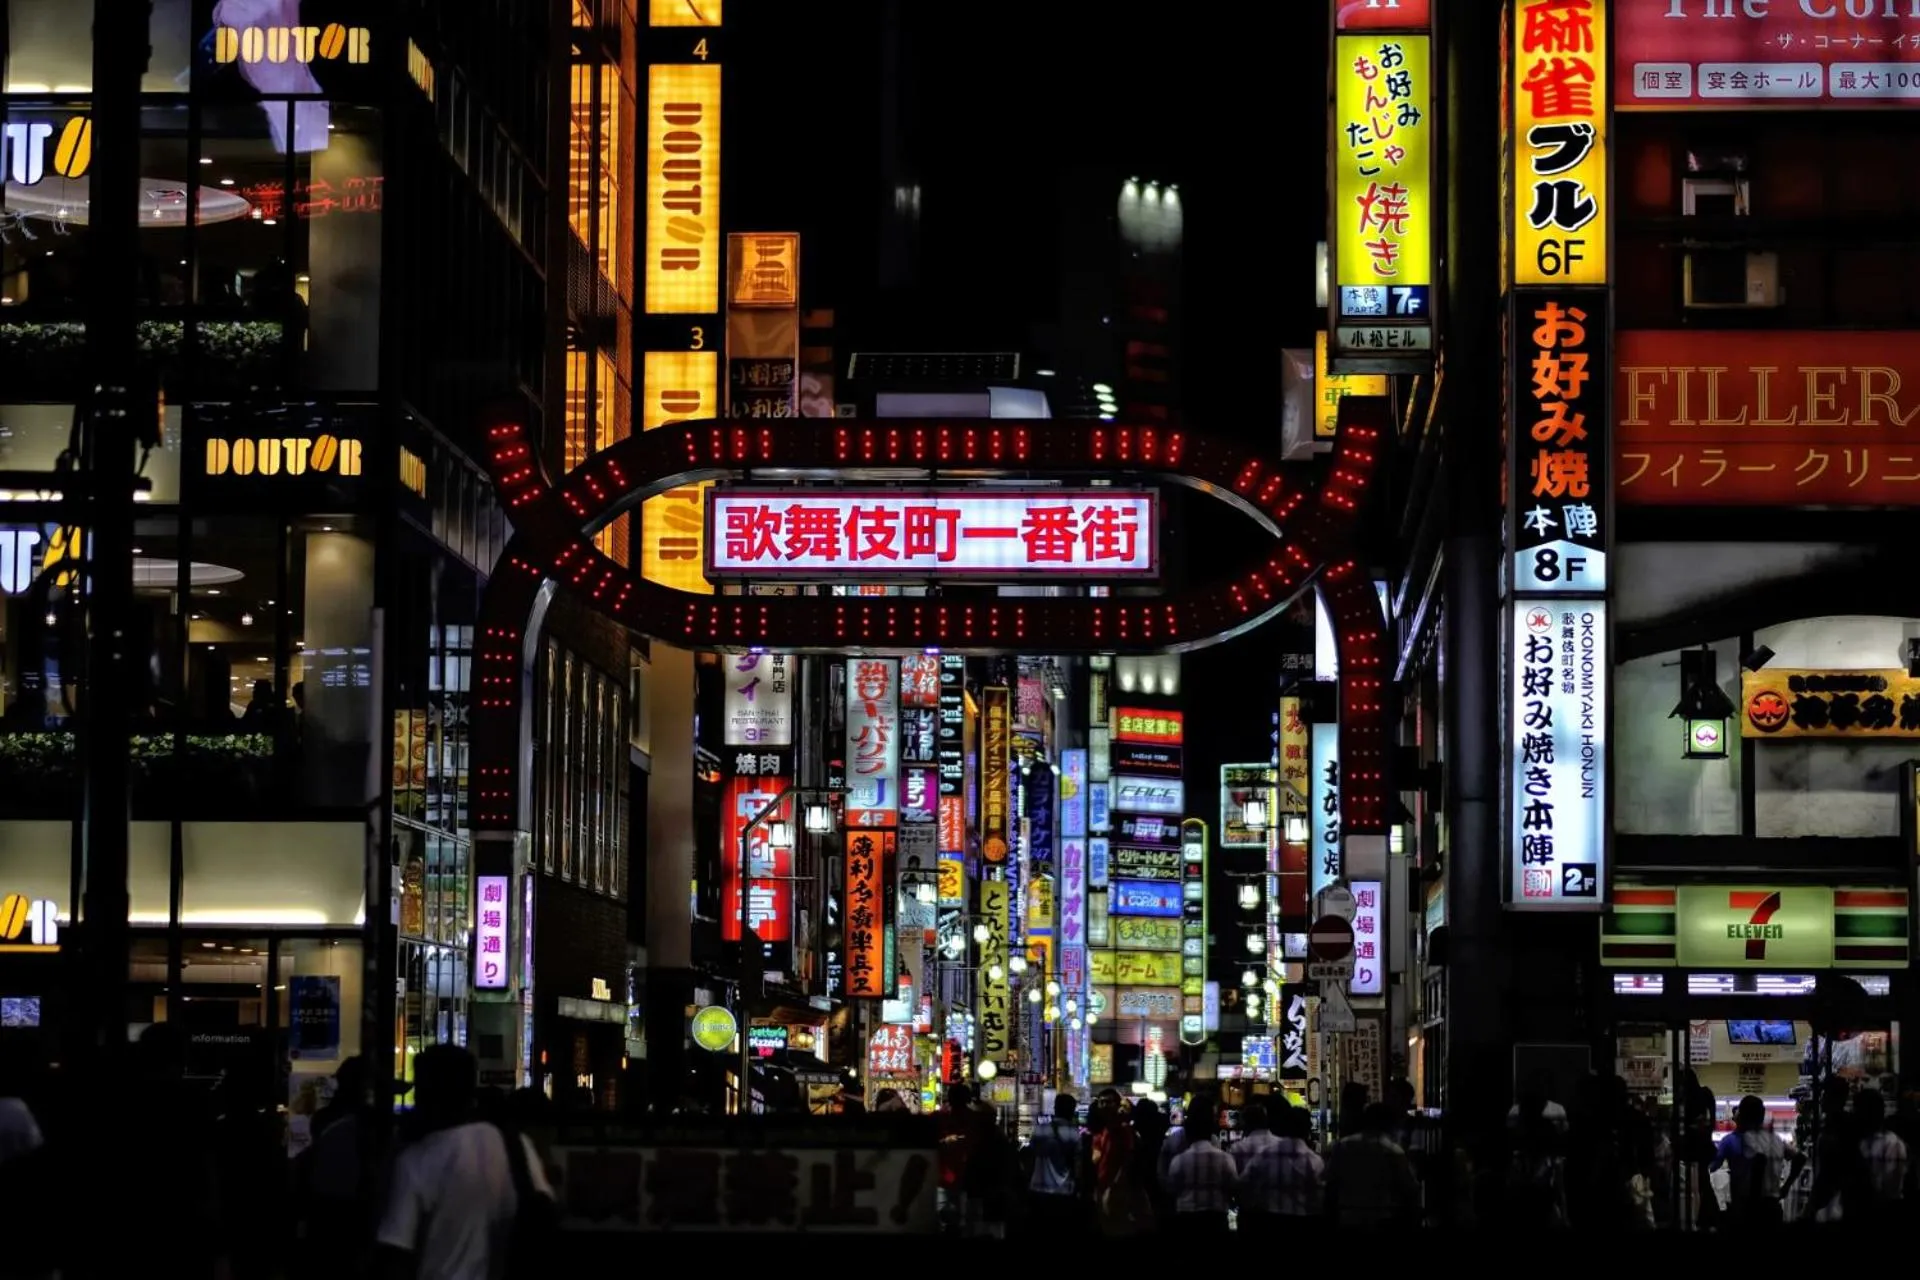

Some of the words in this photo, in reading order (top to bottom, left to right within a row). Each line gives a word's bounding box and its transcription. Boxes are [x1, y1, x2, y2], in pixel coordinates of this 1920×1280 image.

[215, 23, 370, 63] DOUTOR
[692, 37, 710, 61] 4
[1378, 43, 1421, 127] お好み
[1642, 71, 1684, 89] 個室
[1707, 71, 1817, 89] 宴会ホール
[1354, 56, 1405, 166] もんじゃ
[1347, 122, 1380, 176] たこ
[660, 102, 706, 271] DOUTOR
[1357, 183, 1410, 276] 焼き
[1537, 239, 1586, 276] 6F
[1391, 287, 1421, 314] 7F
[690, 326, 705, 350] 3
[1351, 330, 1415, 348] 小松ビル
[1530, 302, 1590, 498] お好み焼
[1620, 366, 1910, 426] FILLER
[206, 434, 362, 476] DOUTOR
[1621, 449, 1777, 487] フィラー
[725, 504, 1139, 563] 歌舞伎町一番街
[1524, 502, 1597, 538] 本陣
[1534, 548, 1587, 582] 8F
[1580, 611, 1594, 730] OKONOMIYAKI
[745, 728, 770, 741] 3F
[1521, 633, 1555, 867] お好み焼き本陣
[735, 753, 781, 774] 焼肉
[1580, 734, 1594, 799] HONJIN
[858, 810, 884, 826] 4F
[1564, 868, 1595, 893] 2F
[482, 883, 503, 979] 劇場通り
[1356, 890, 1376, 984] 劇場通り
